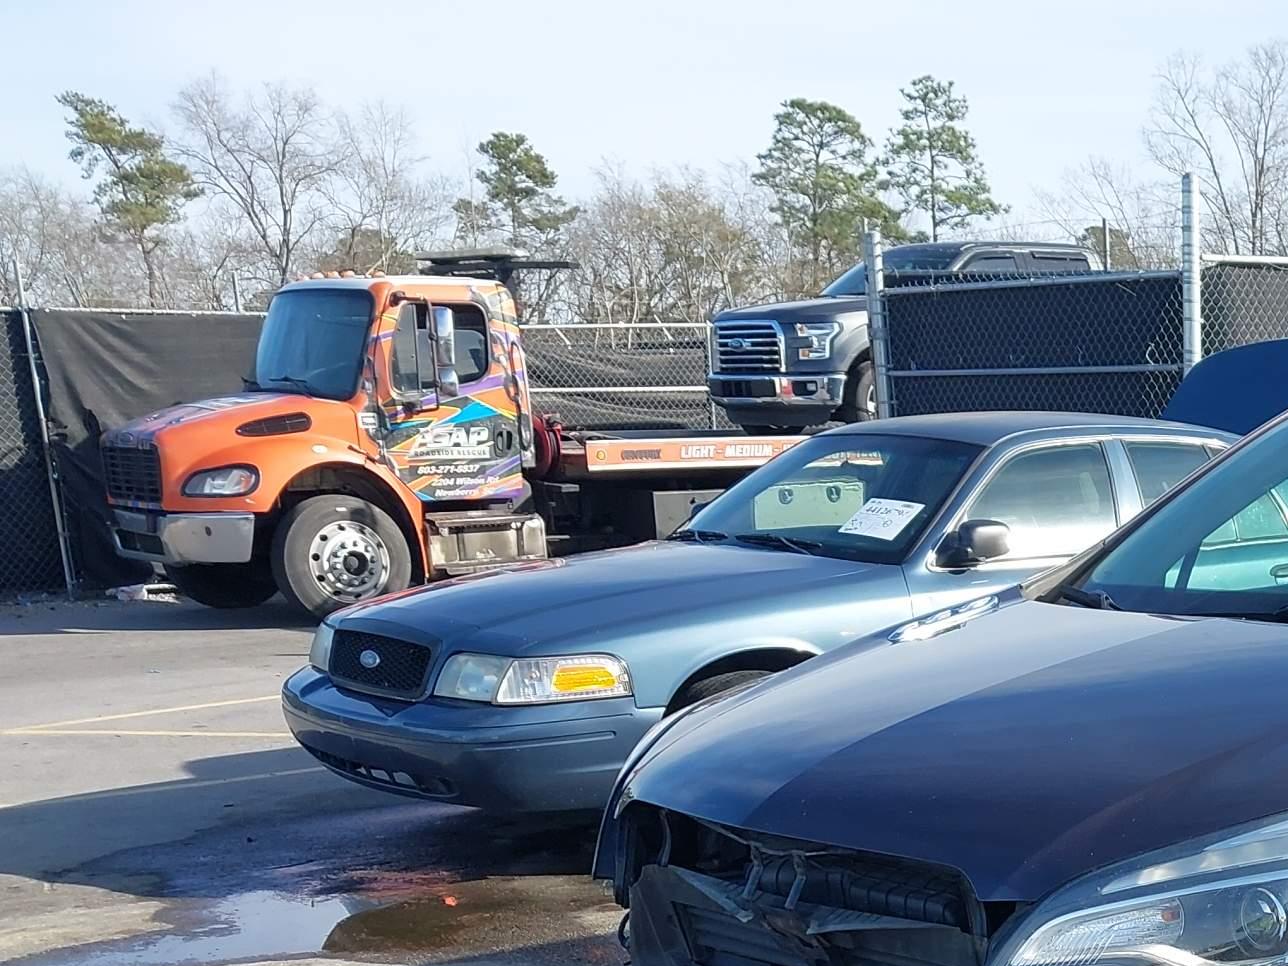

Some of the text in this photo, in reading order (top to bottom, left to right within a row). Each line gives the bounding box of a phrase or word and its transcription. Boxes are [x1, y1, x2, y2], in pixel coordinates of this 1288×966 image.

[415, 427, 488, 447] ASAP
[680, 445, 716, 459] LIGHT
[725, 444, 773, 458] MEDIUM
